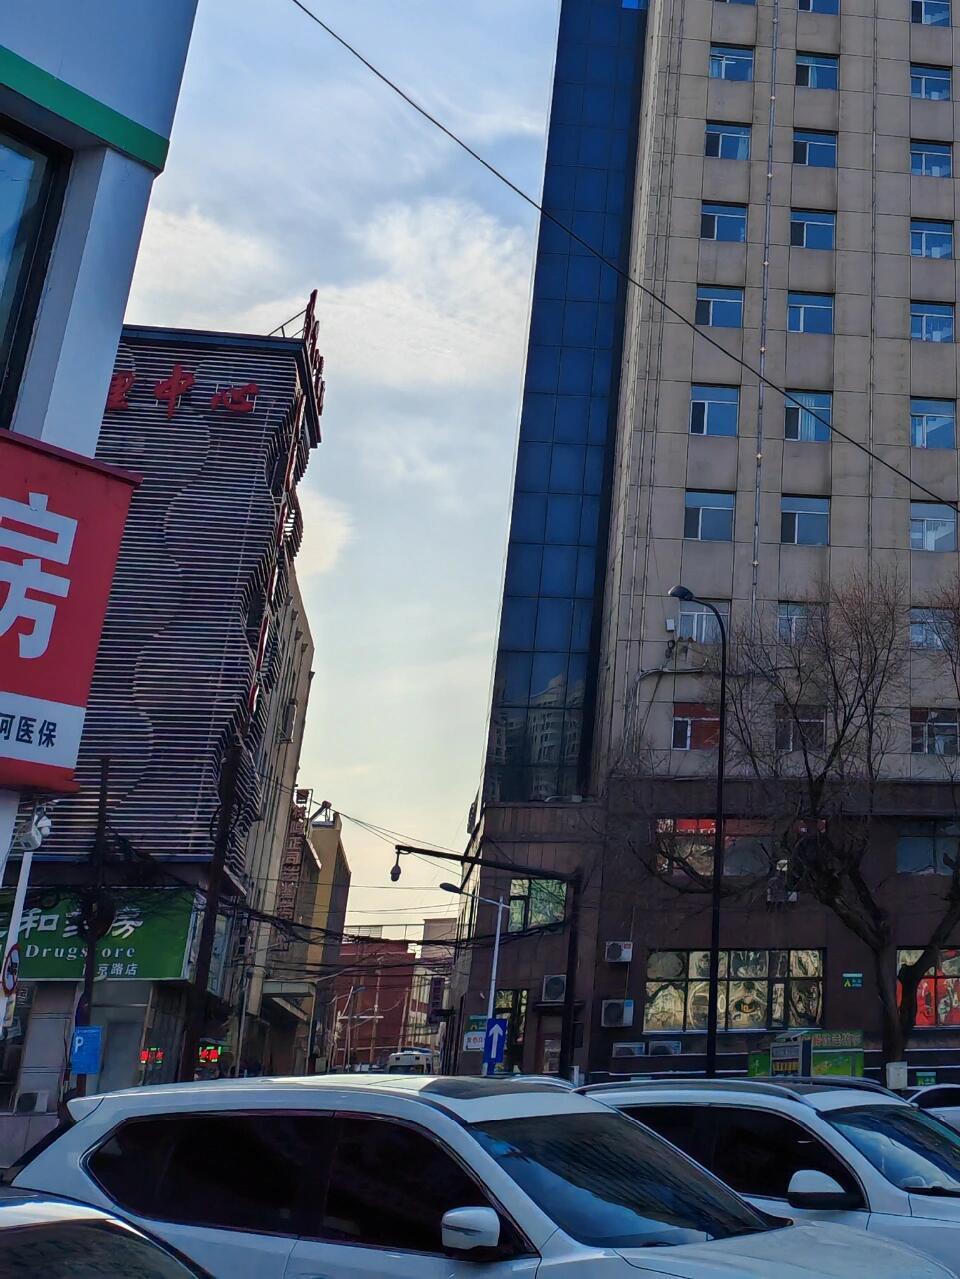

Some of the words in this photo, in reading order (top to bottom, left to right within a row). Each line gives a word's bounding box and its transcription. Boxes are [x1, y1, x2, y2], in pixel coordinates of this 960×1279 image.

[25, 944, 136, 960] Drugsore
[82, 963, 138, 976] 京路店
